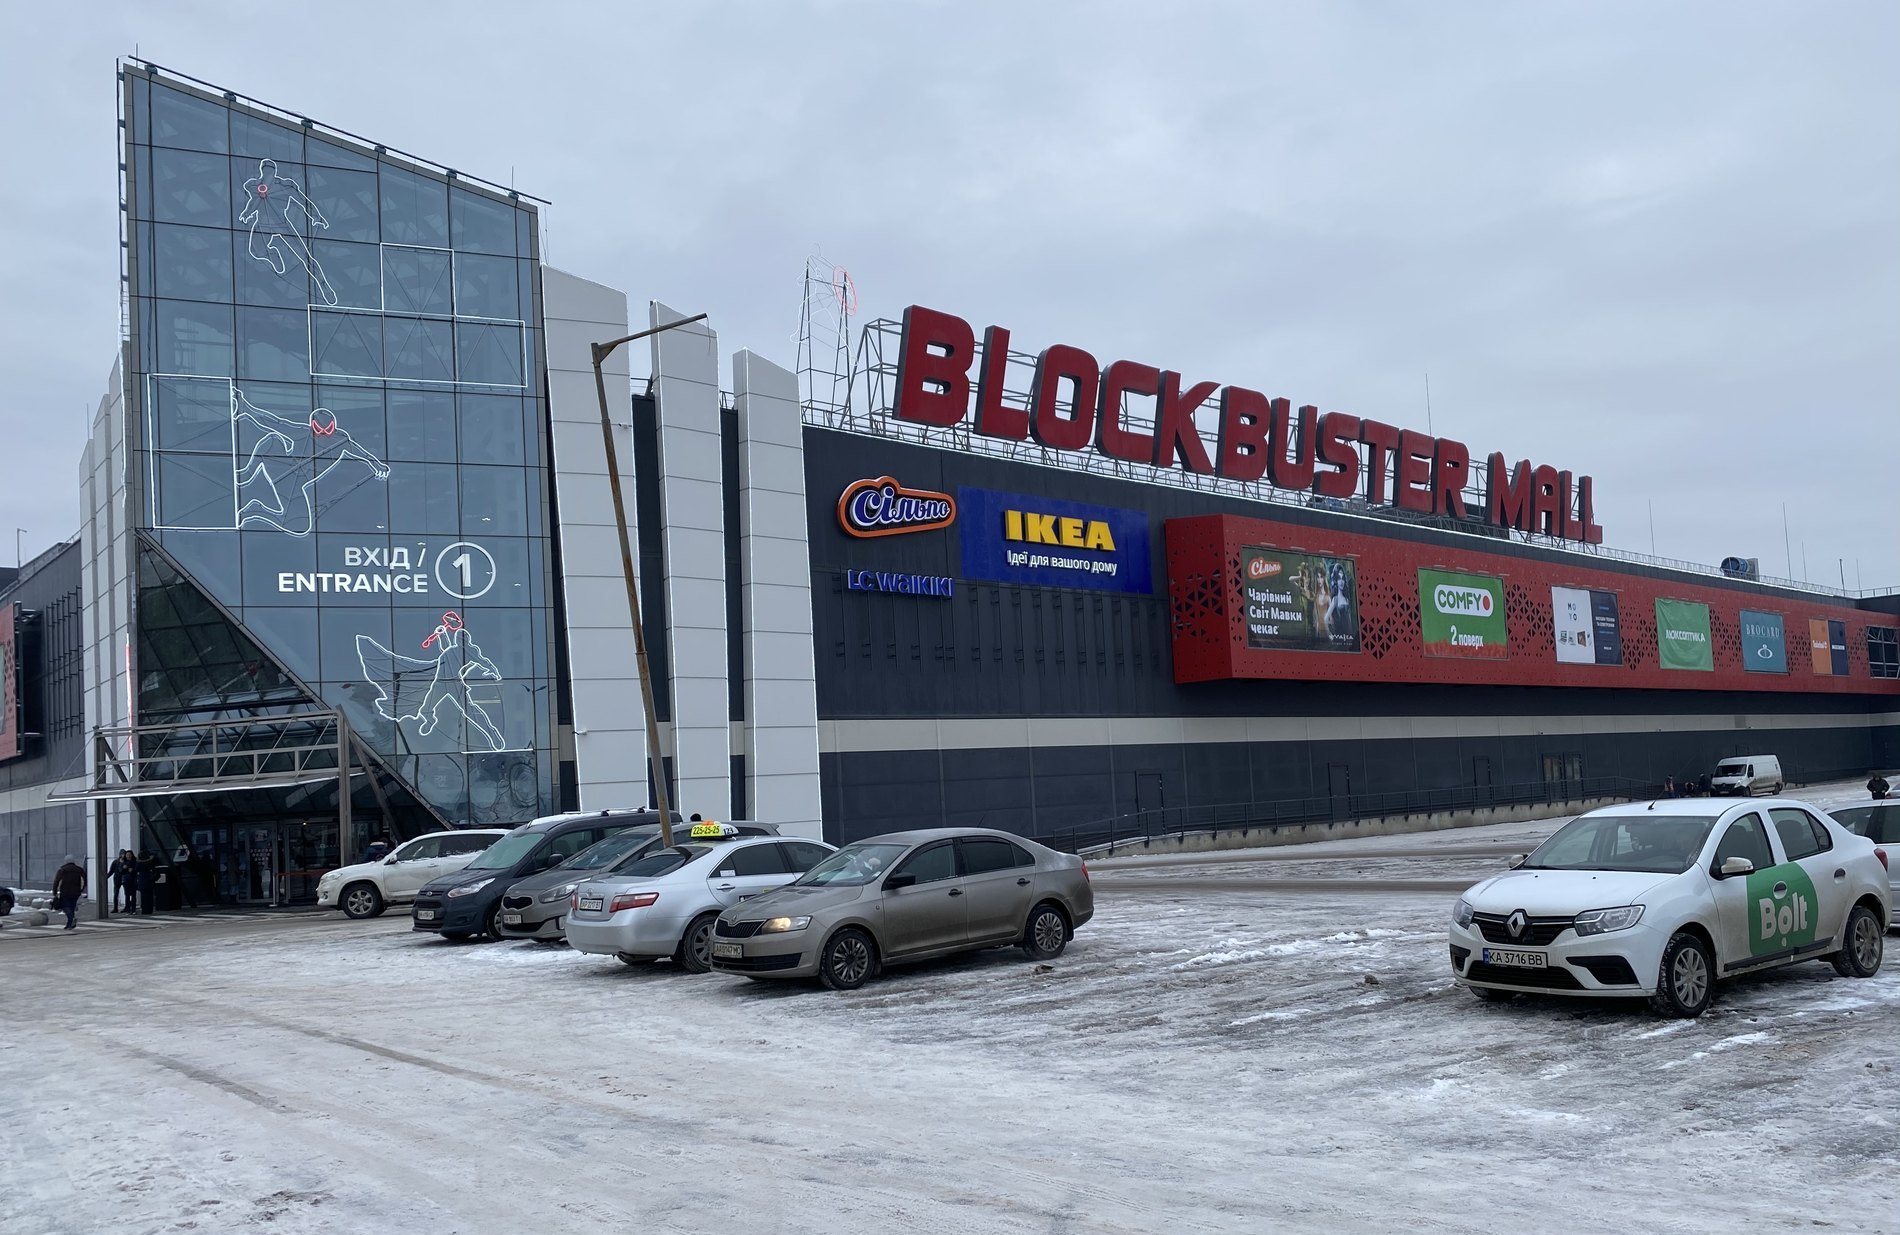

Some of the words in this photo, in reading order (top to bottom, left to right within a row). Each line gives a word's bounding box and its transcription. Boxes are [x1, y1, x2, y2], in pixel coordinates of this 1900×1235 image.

[892, 304, 1469, 518] BLOCKBUSTER
[1486, 450, 1604, 544] MALL
[849, 486, 951, 527] Сільпо
[1005, 509, 1117, 551] IKEA
[344, 546, 411, 570] ВХІД
[1006, 549, 1028, 566] Ідеї
[1029, 554, 1049, 569] для
[1050, 556, 1090, 570] вашого
[1091, 560, 1118, 577] дому
[278, 572, 429, 593] ENTRANCE
[451, 553, 472, 588] 1
[847, 568, 875, 591] LC
[1248, 587, 1292, 605] Чарівний
[1437, 589, 1482, 611] COMFY
[1249, 605, 1270, 619] Світ
[1270, 606, 1303, 622] Мавки
[1450, 624, 1458, 646] 2
[1458, 633, 1484, 650] поверх
[692, 825, 720, 835] 225-25-25
[1758, 892, 1808, 940] Bolt
[1489, 951, 1503, 963] KA
[1504, 952, 1526, 965] 3716
[1528, 954, 1543, 966] BB
